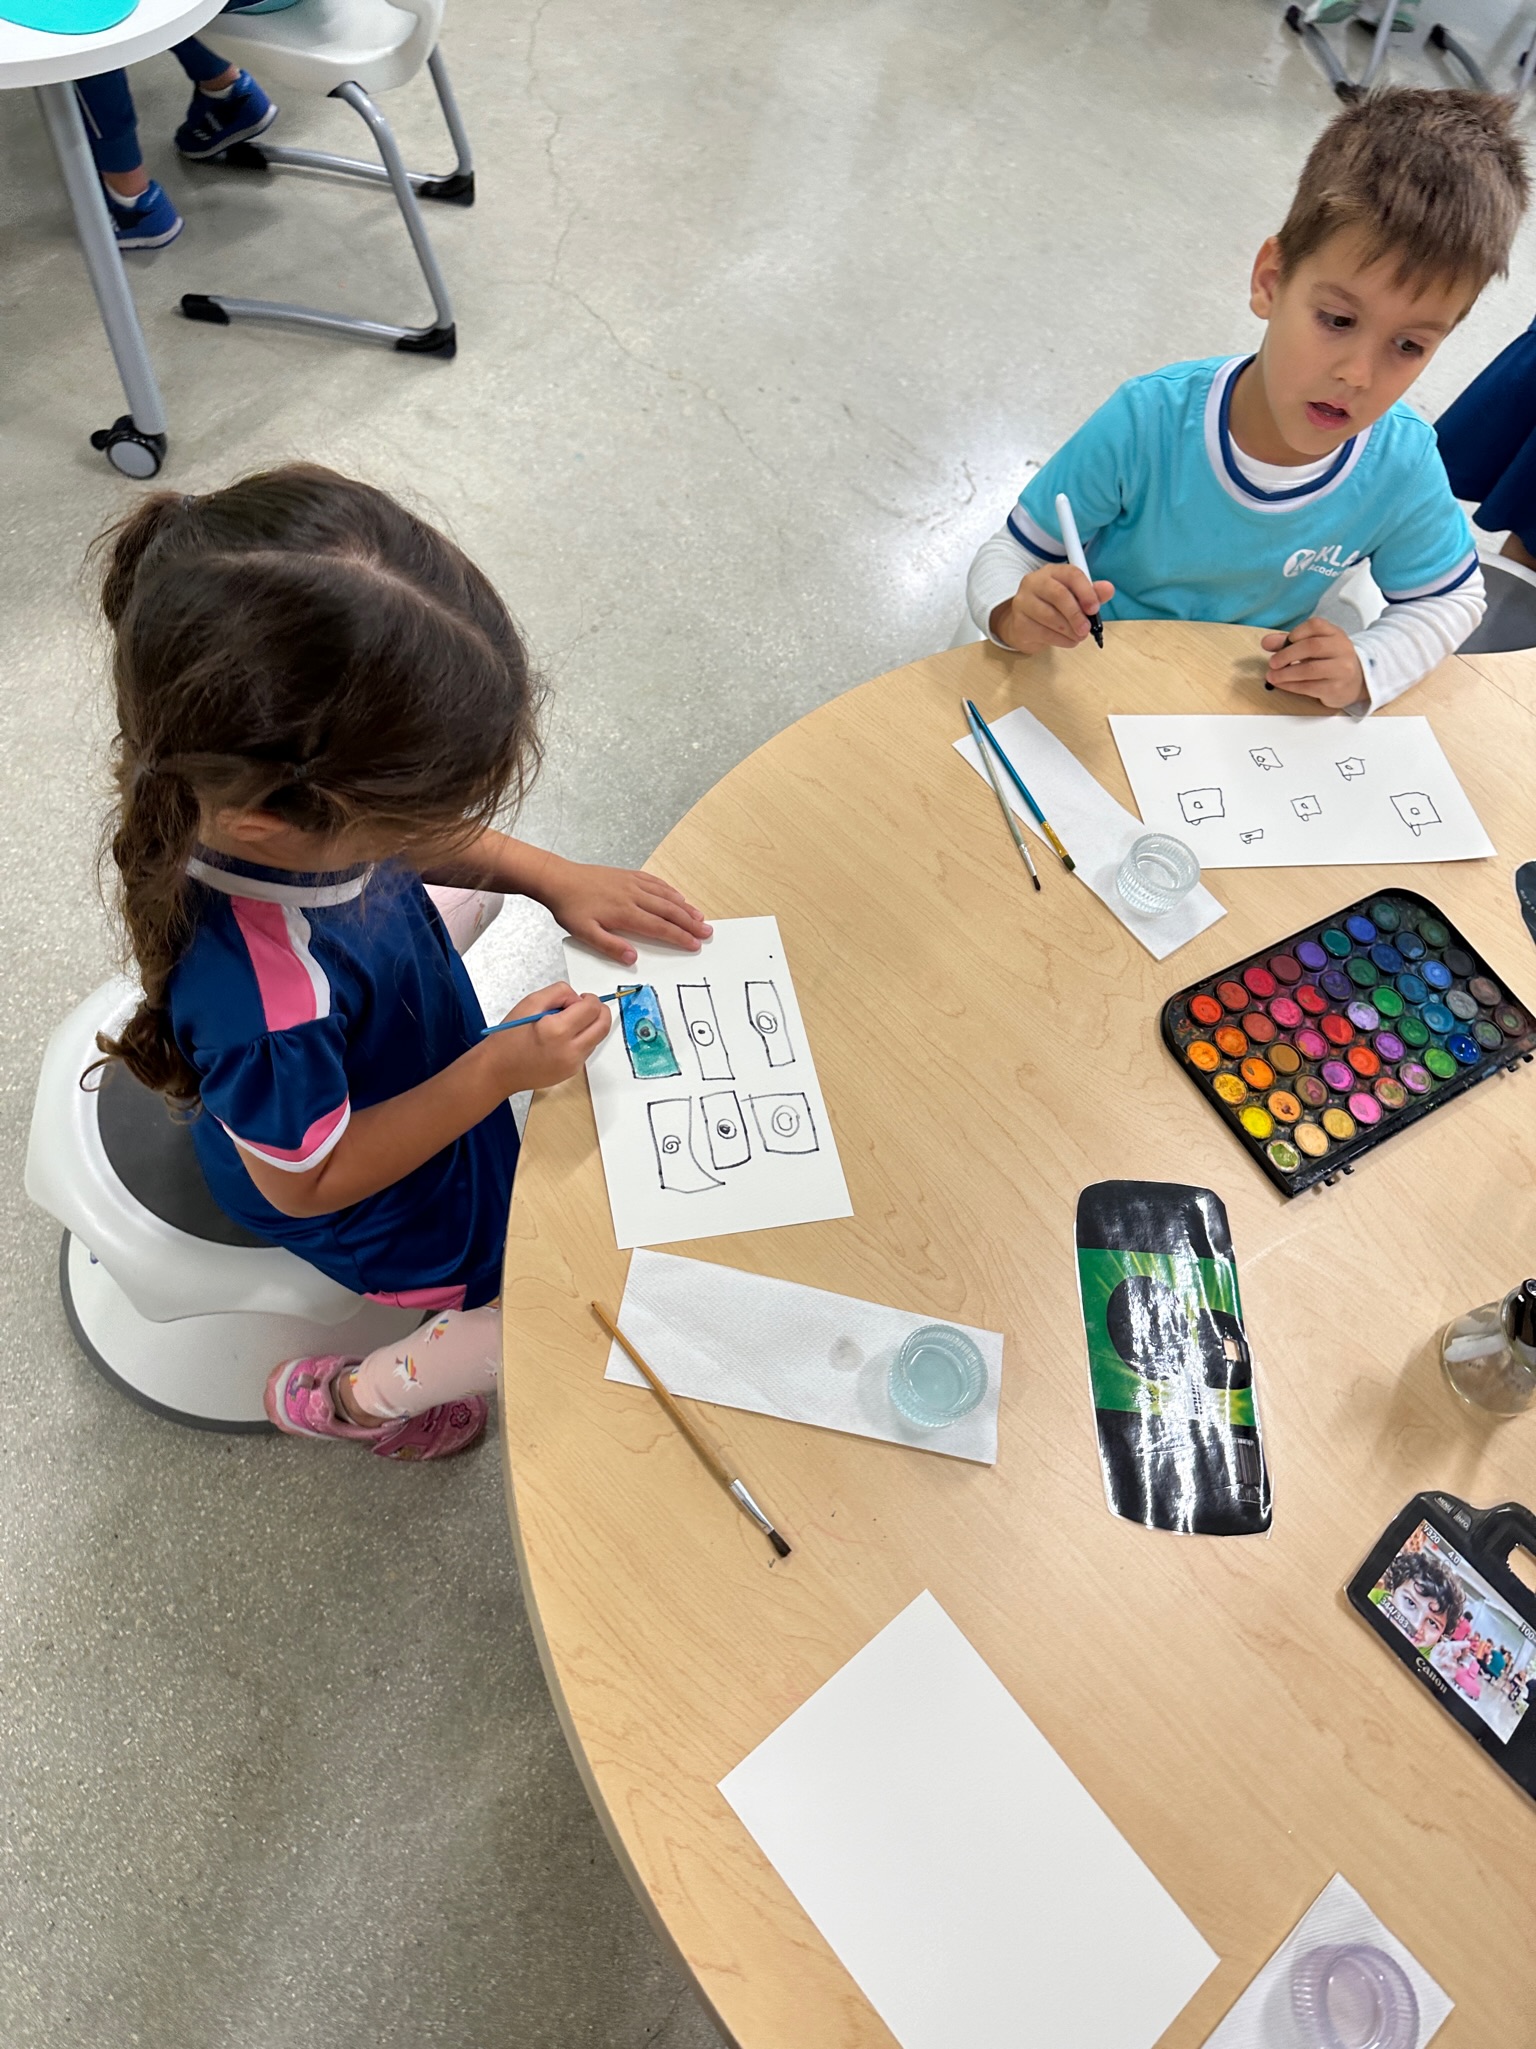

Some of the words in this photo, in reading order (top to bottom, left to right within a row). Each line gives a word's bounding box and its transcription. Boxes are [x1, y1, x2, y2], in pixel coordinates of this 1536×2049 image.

[1308, 564, 1341, 577] Acade
[1447, 1550, 1460, 1564] 4.0
[1379, 1596, 1409, 1629] 344/383
[1415, 1656, 1448, 1694] Canon
